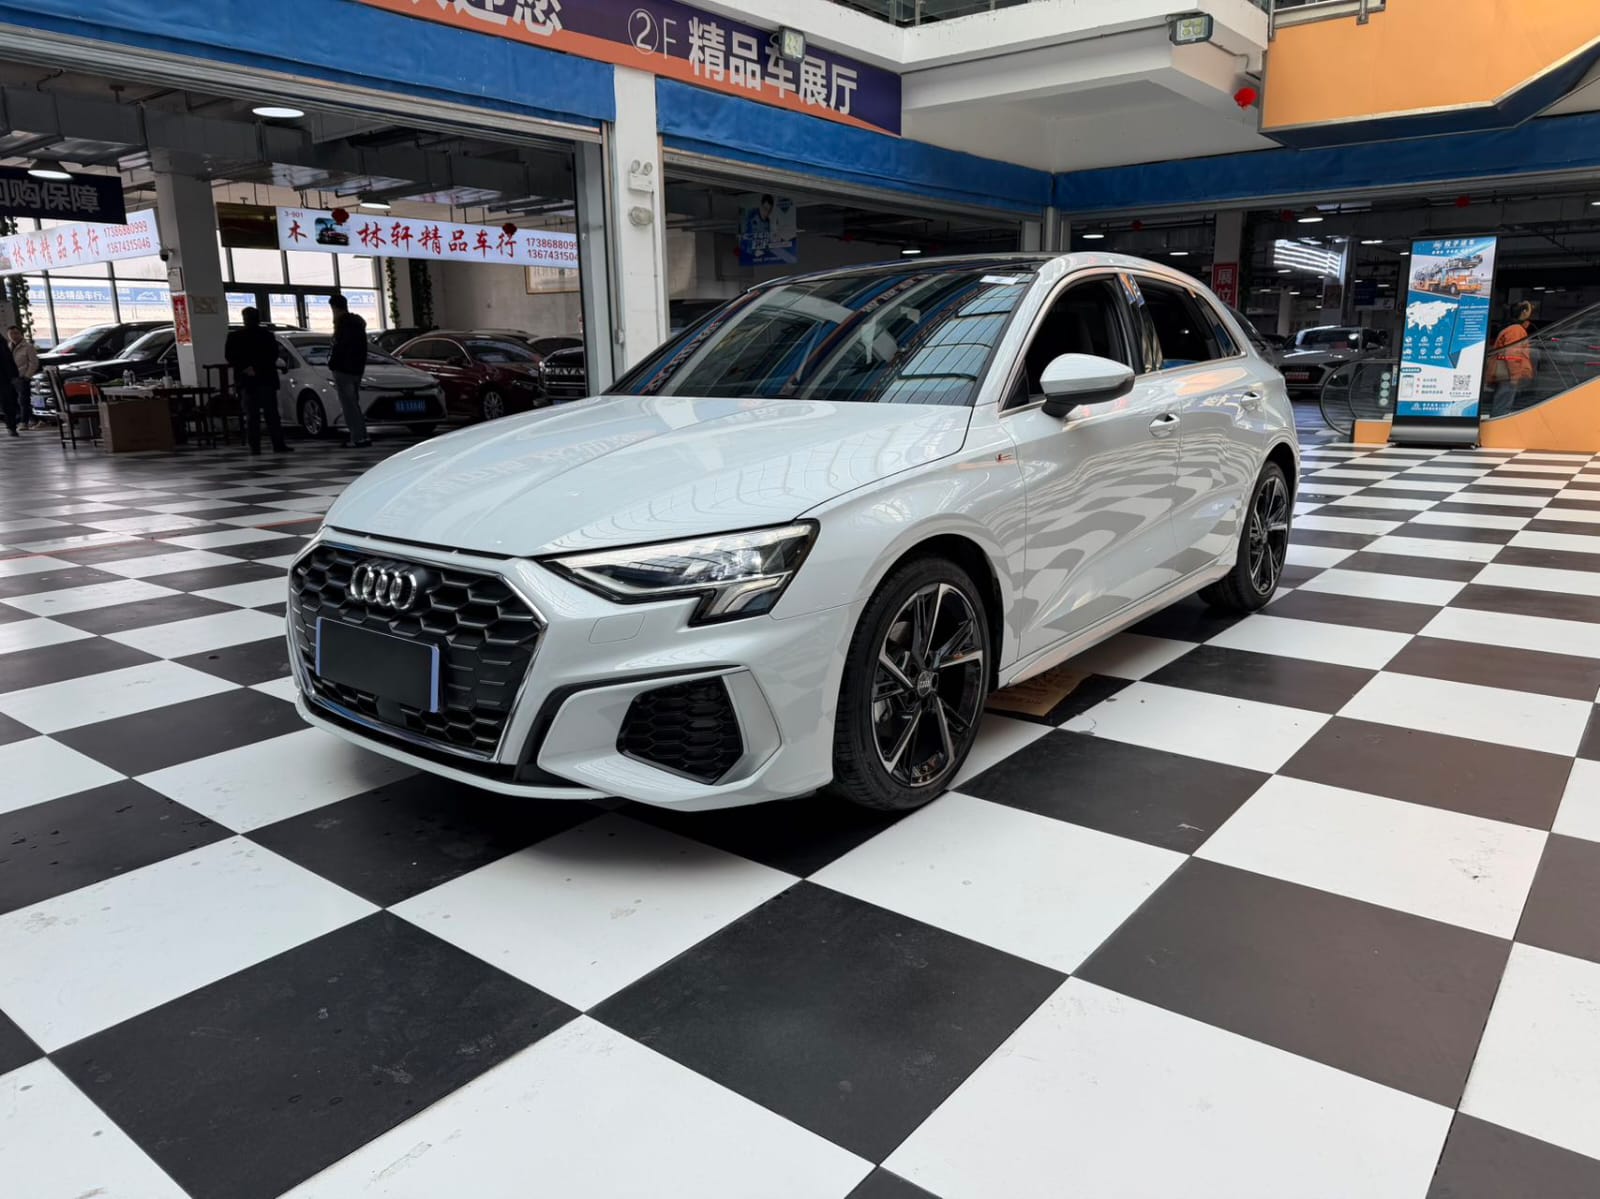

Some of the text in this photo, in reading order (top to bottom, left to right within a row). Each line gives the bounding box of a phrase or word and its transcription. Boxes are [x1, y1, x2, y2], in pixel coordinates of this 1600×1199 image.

[688, 16, 858, 115] 精品车展厅
[288, 219, 518, 259] 木 林轩精品车行
[526, 237, 578, 250] 1738688099
[527, 249, 578, 262] 136743150
[551, 367, 582, 376] HAVA
